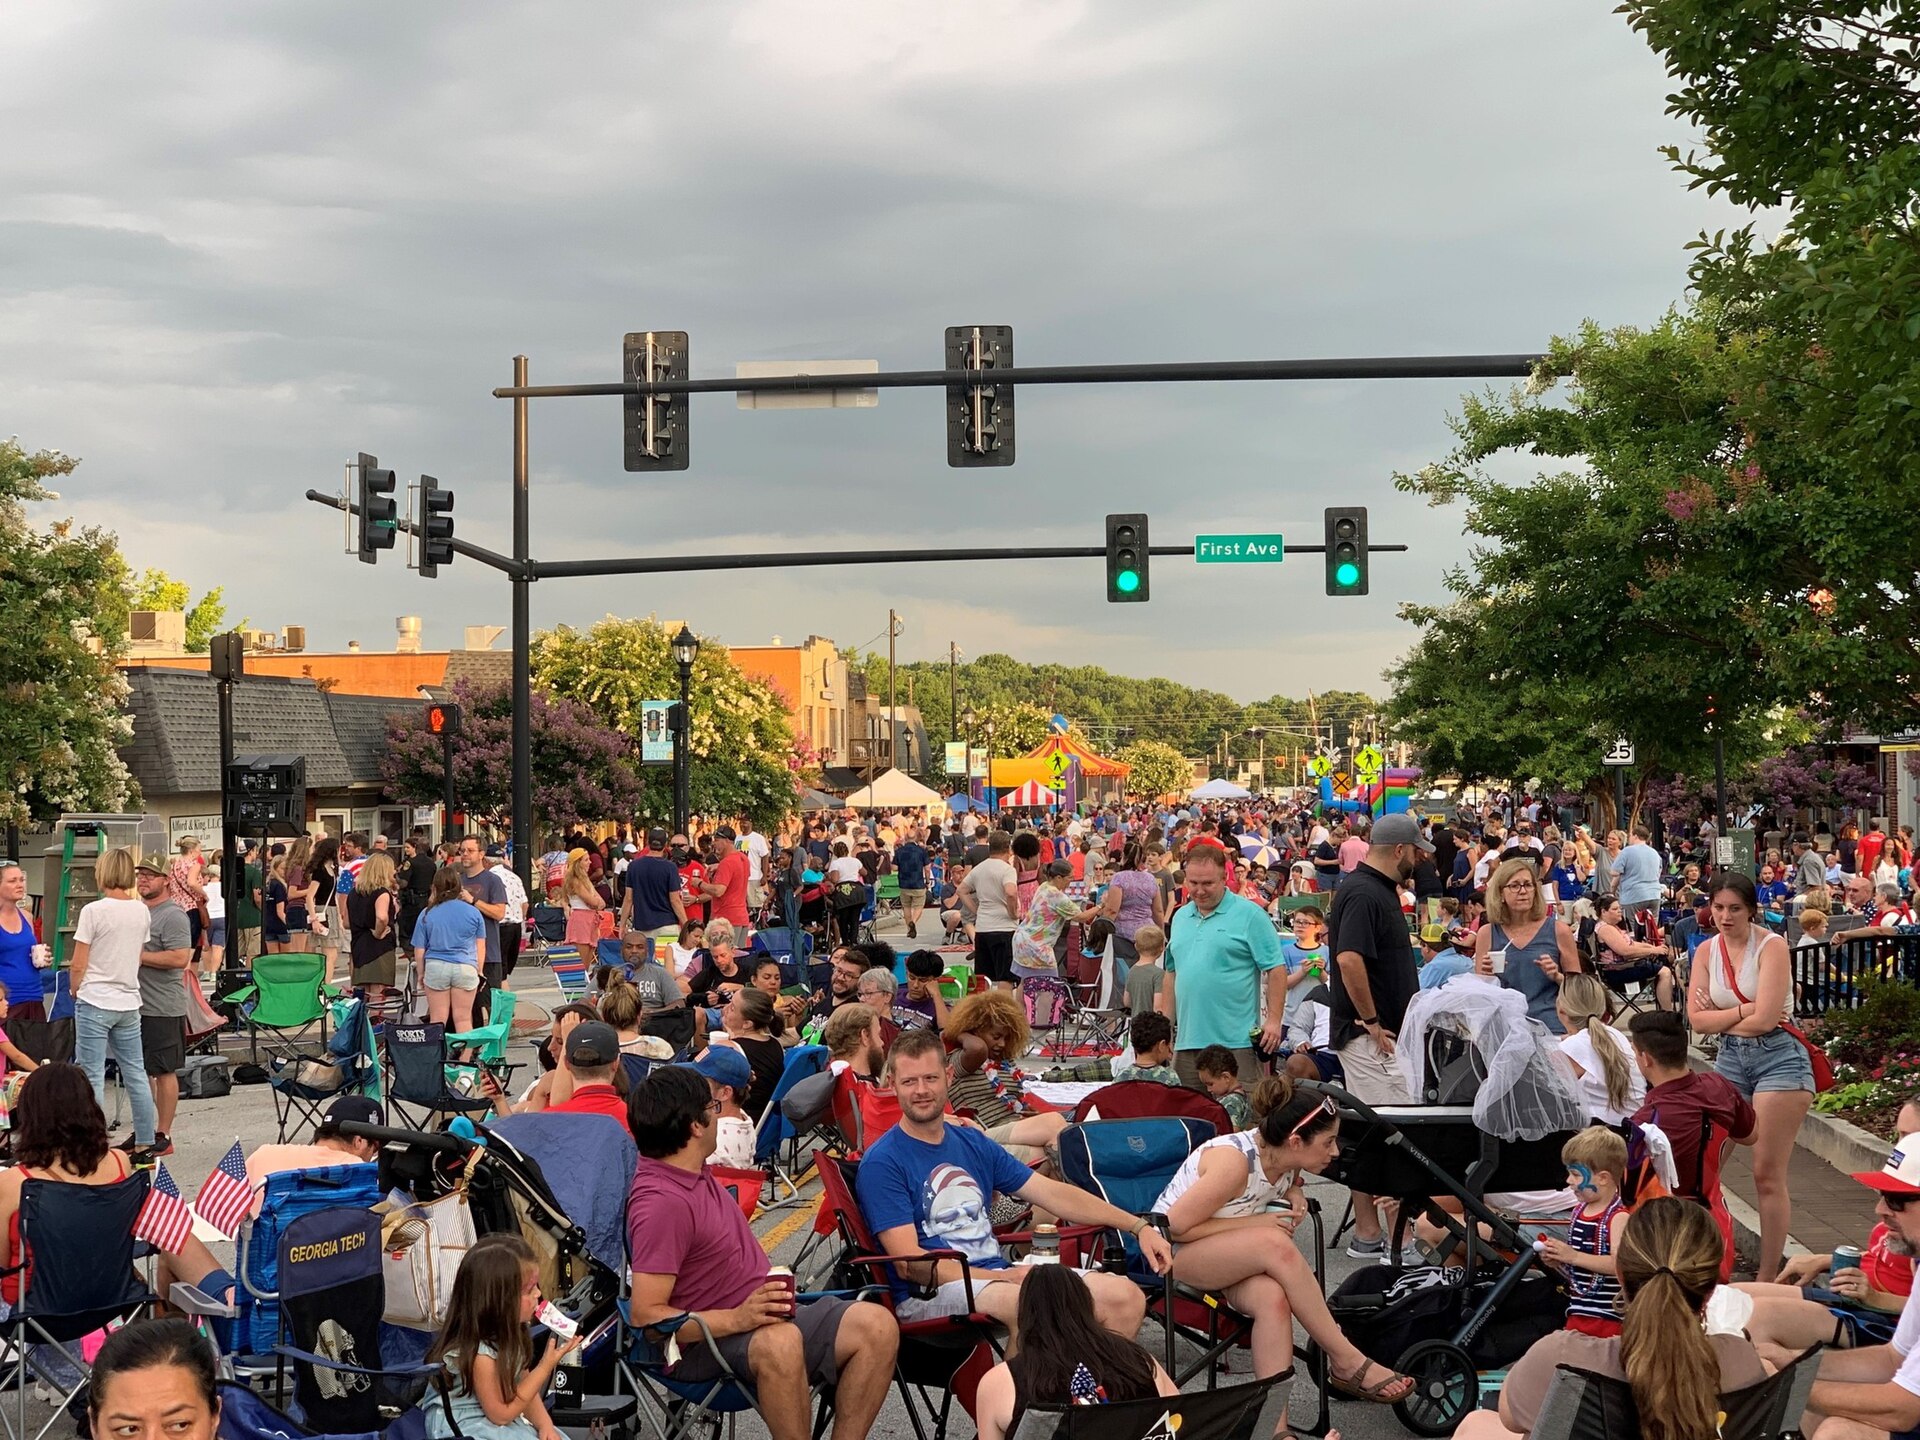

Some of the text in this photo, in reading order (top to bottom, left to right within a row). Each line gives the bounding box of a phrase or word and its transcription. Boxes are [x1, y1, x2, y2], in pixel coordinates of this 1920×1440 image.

[1200, 542, 1278, 556] First Ave
[1606, 745, 1631, 759] 25
[637, 980, 656, 993] EGO
[396, 1029, 426, 1039] SPORTS
[1410, 1146, 1429, 1167] VISTA
[290, 1231, 366, 1263] GEORGIA TECH
